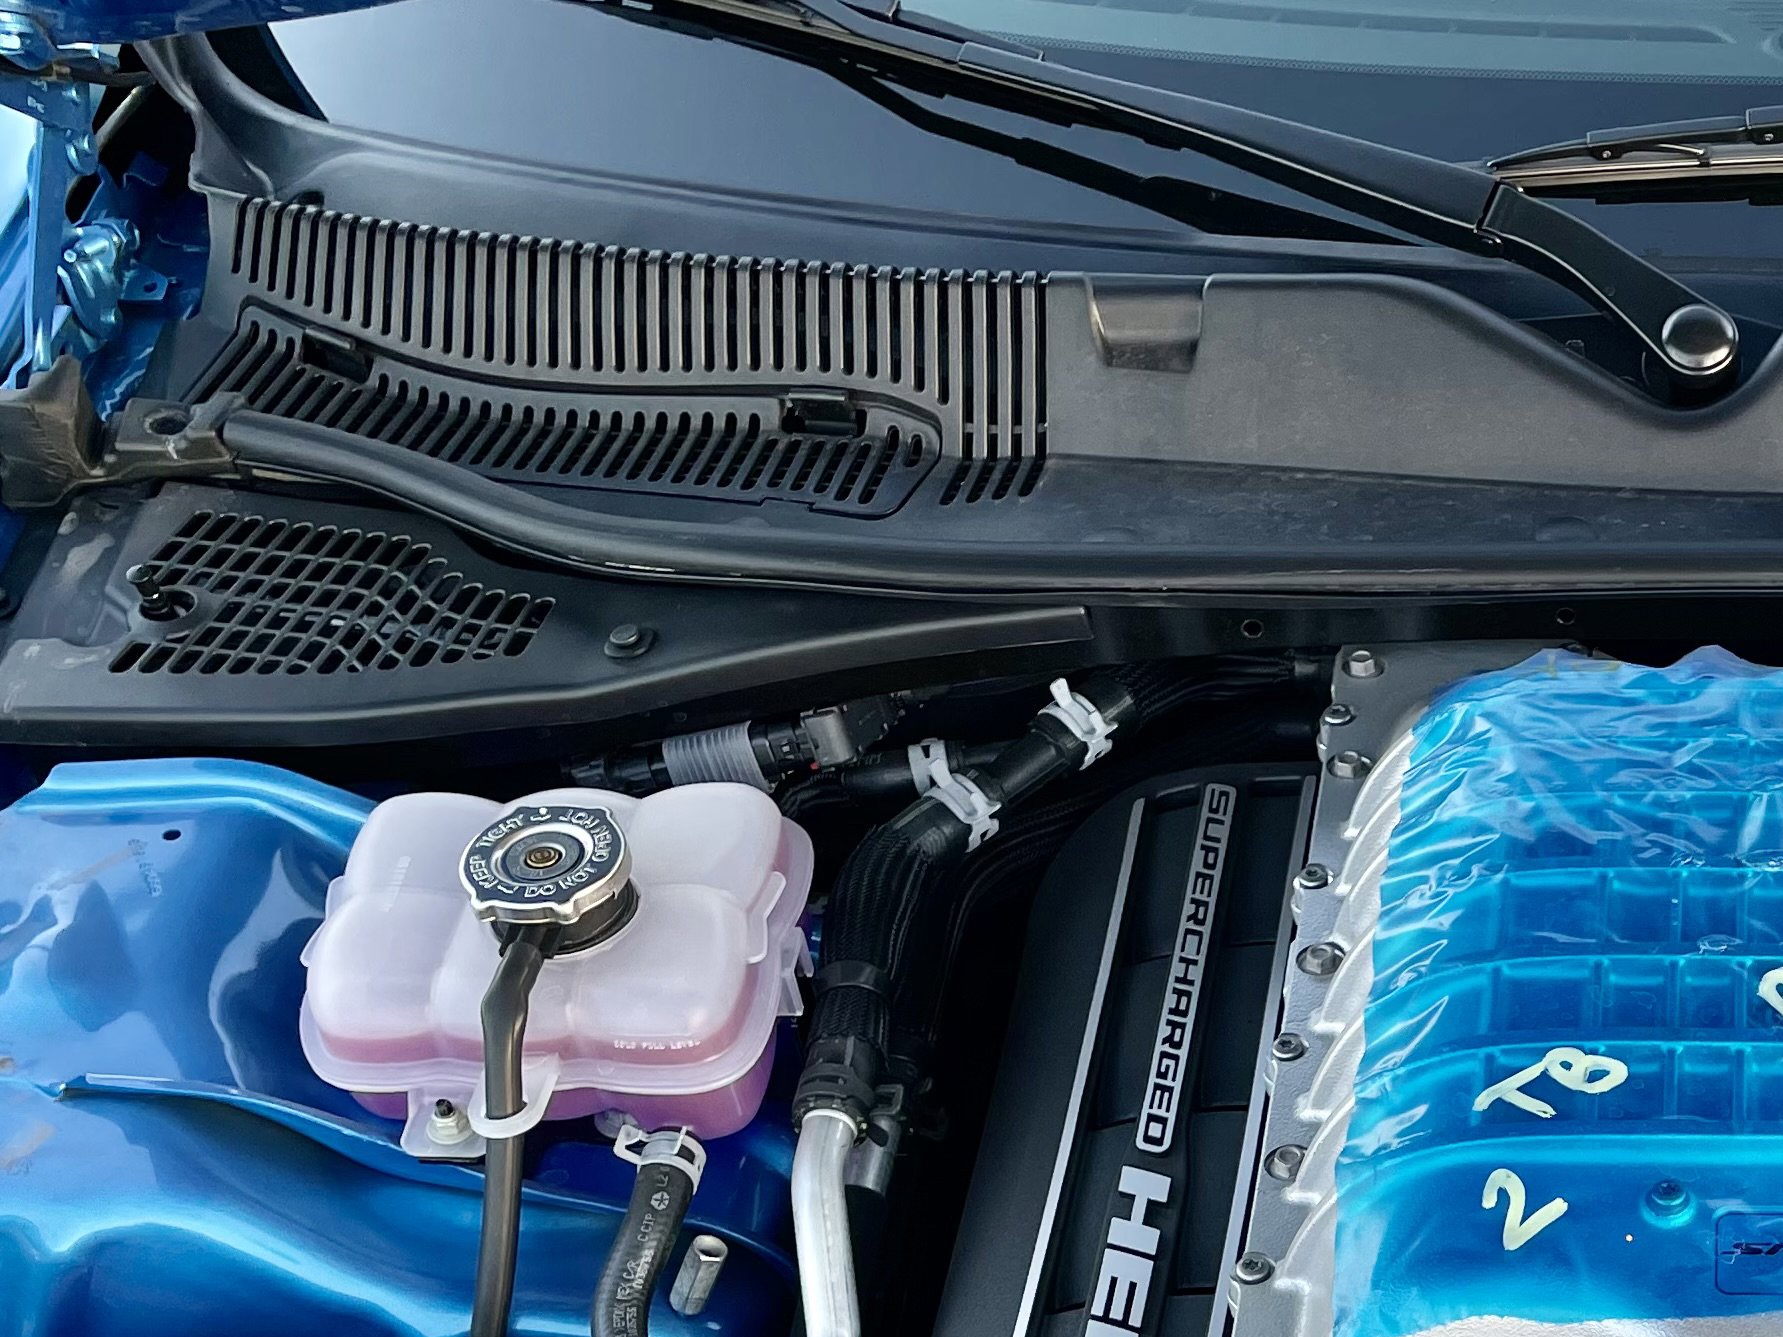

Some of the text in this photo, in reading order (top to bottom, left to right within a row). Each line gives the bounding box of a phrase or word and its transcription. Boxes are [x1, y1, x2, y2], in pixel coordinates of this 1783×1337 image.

[469, 813, 524, 888] KEEP TIGHT
[524, 885, 557, 898] DO
[558, 862, 598, 890] NOT
[1142, 788, 1233, 1147] SUPERCHARGED
[1482, 1168, 1568, 1251] 2
